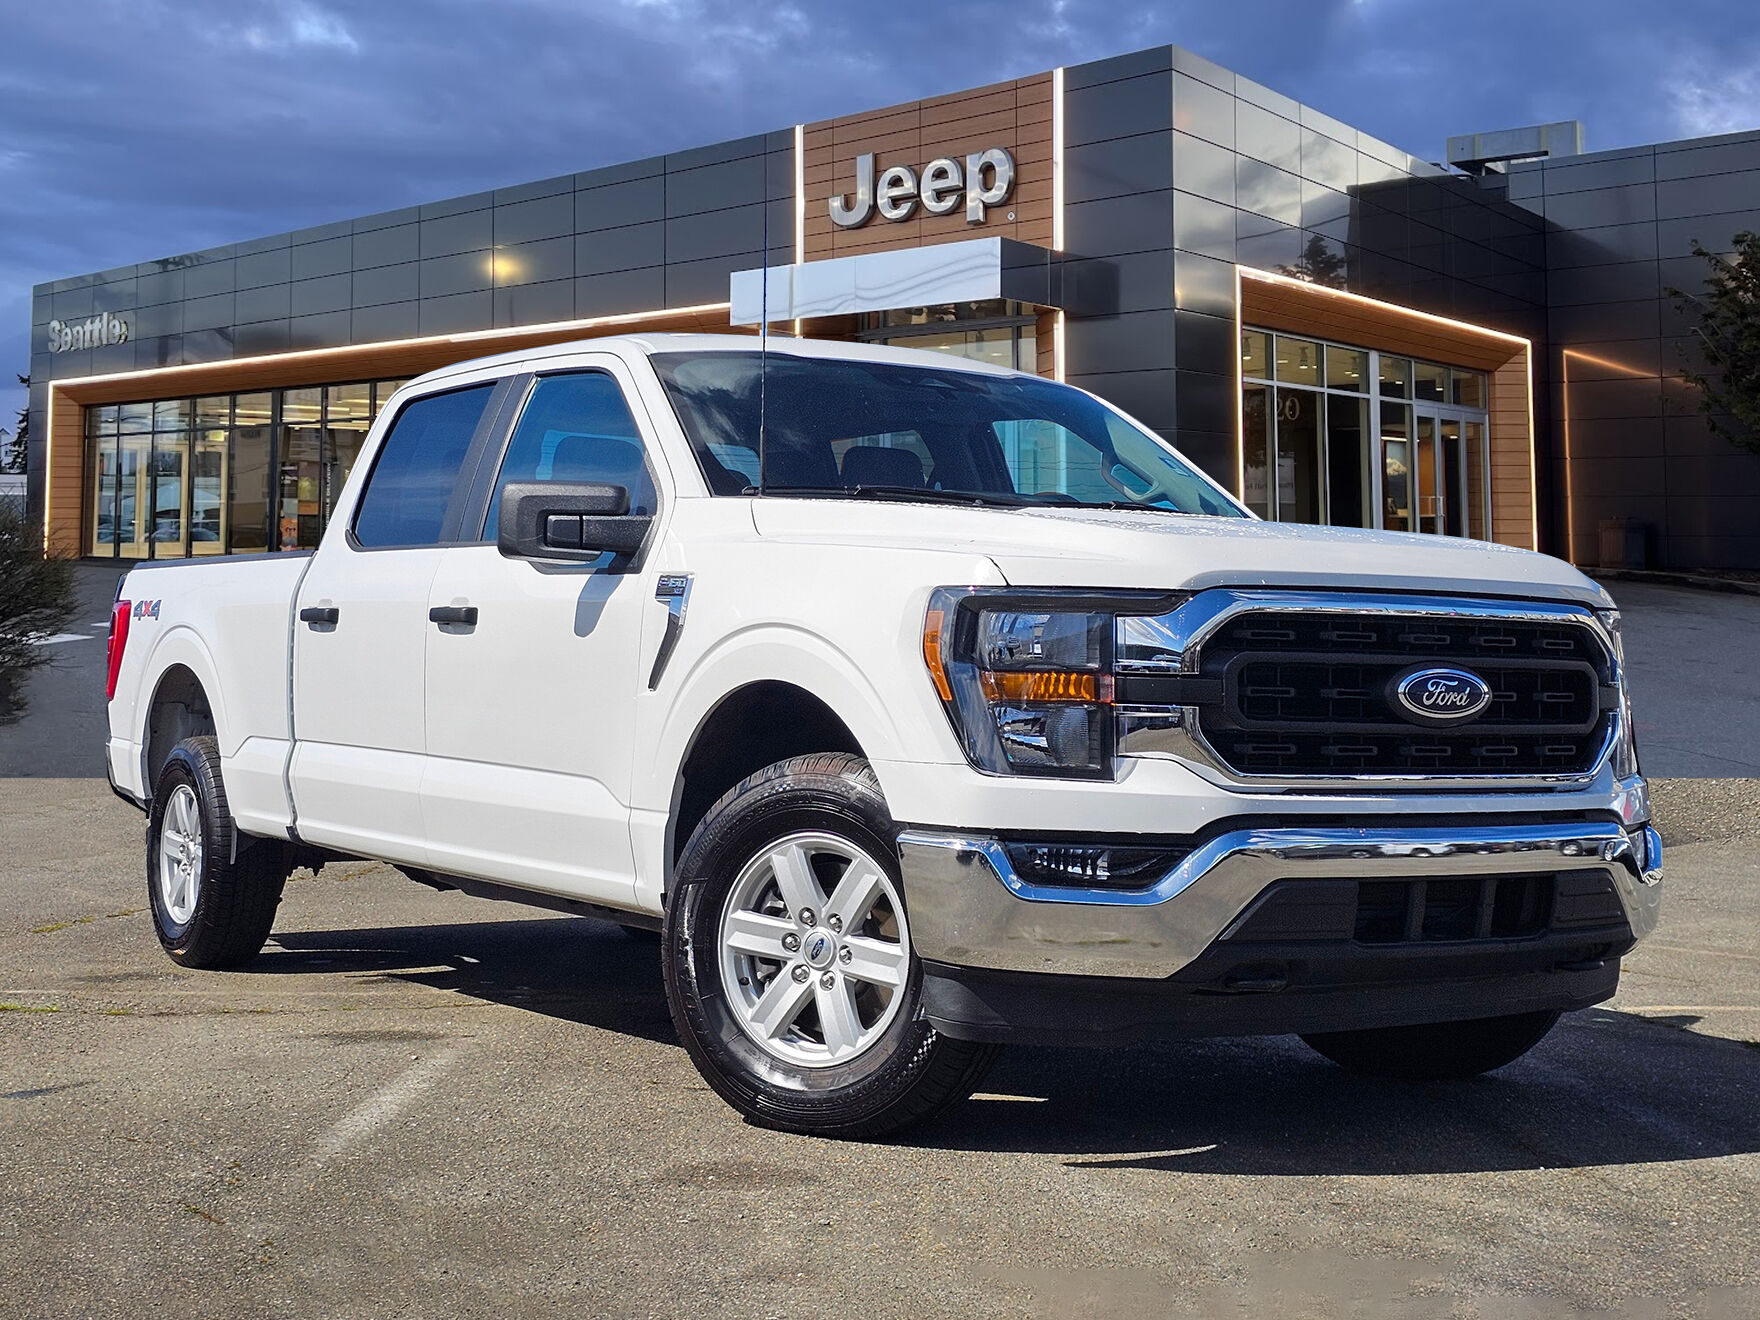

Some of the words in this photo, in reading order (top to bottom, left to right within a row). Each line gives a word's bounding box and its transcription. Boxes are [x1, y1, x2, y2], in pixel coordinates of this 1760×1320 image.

[829, 147, 1015, 229] Jeep
[48, 311, 127, 353] Seattle
[1423, 679, 1470, 705] Ford
